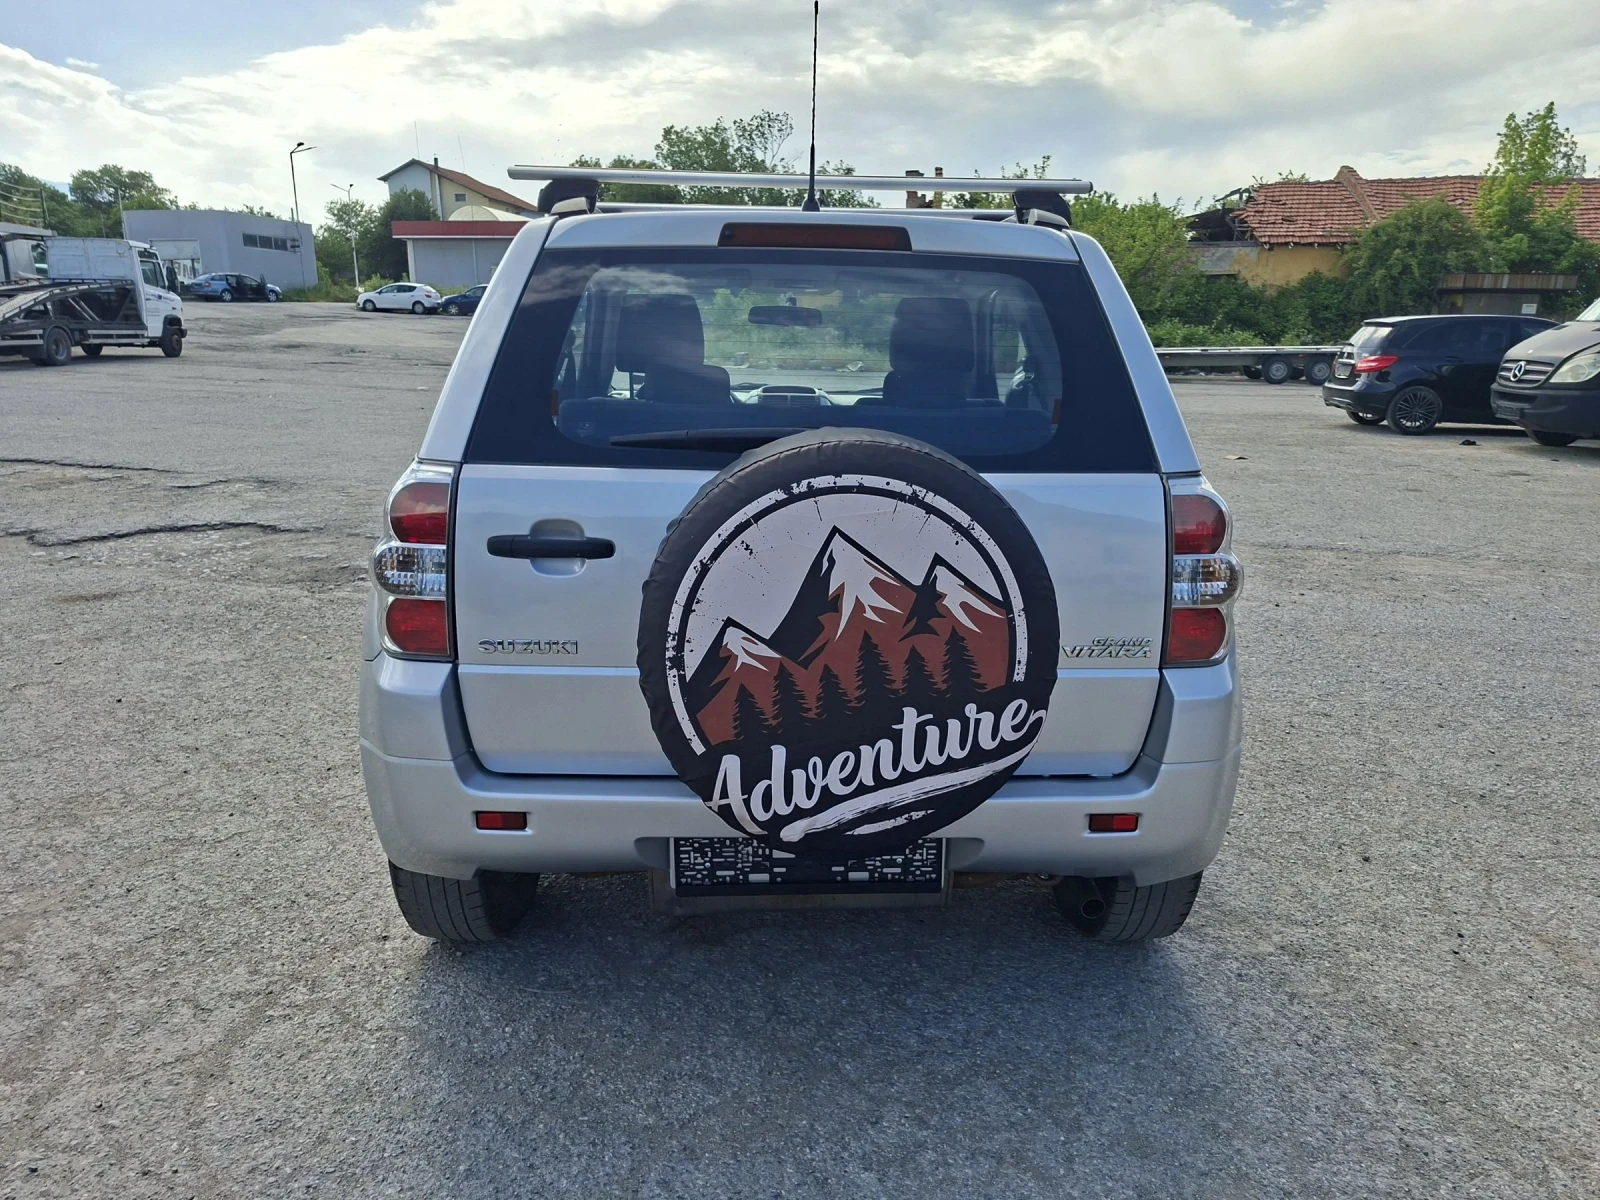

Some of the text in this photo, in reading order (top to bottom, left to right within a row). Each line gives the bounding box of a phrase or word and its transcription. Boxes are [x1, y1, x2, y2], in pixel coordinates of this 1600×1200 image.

[478, 638, 579, 655] SUZUKI
[1092, 637, 1153, 647] GRAND
[1061, 646, 1152, 659] VITARA
[704, 698, 1046, 835] Adventure
